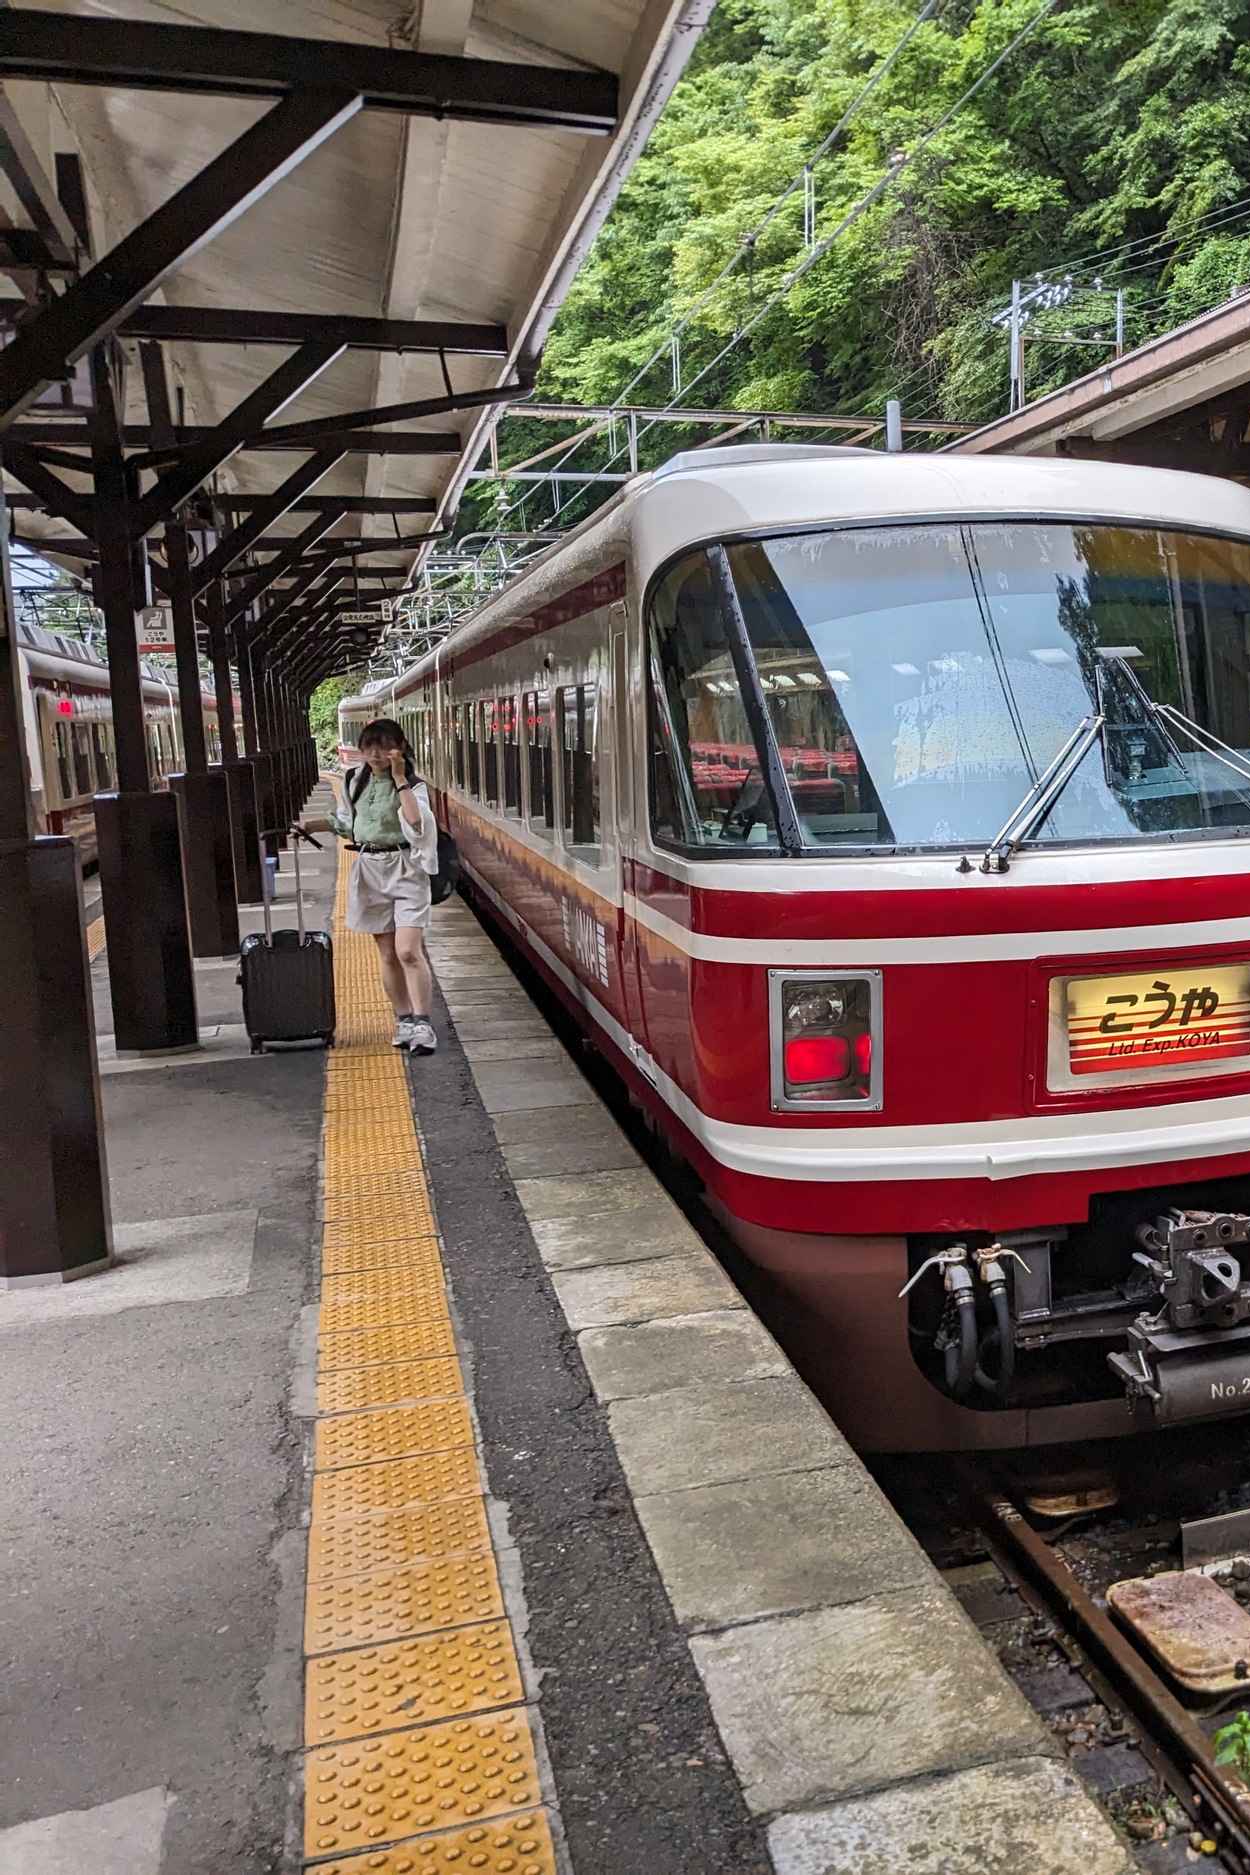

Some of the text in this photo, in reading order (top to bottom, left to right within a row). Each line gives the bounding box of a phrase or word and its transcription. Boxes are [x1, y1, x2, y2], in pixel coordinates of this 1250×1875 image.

[1100, 981, 1219, 1033] こうや
[1108, 1041, 1136, 1056] Ltd.
[1142, 1038, 1174, 1054] Exp.
